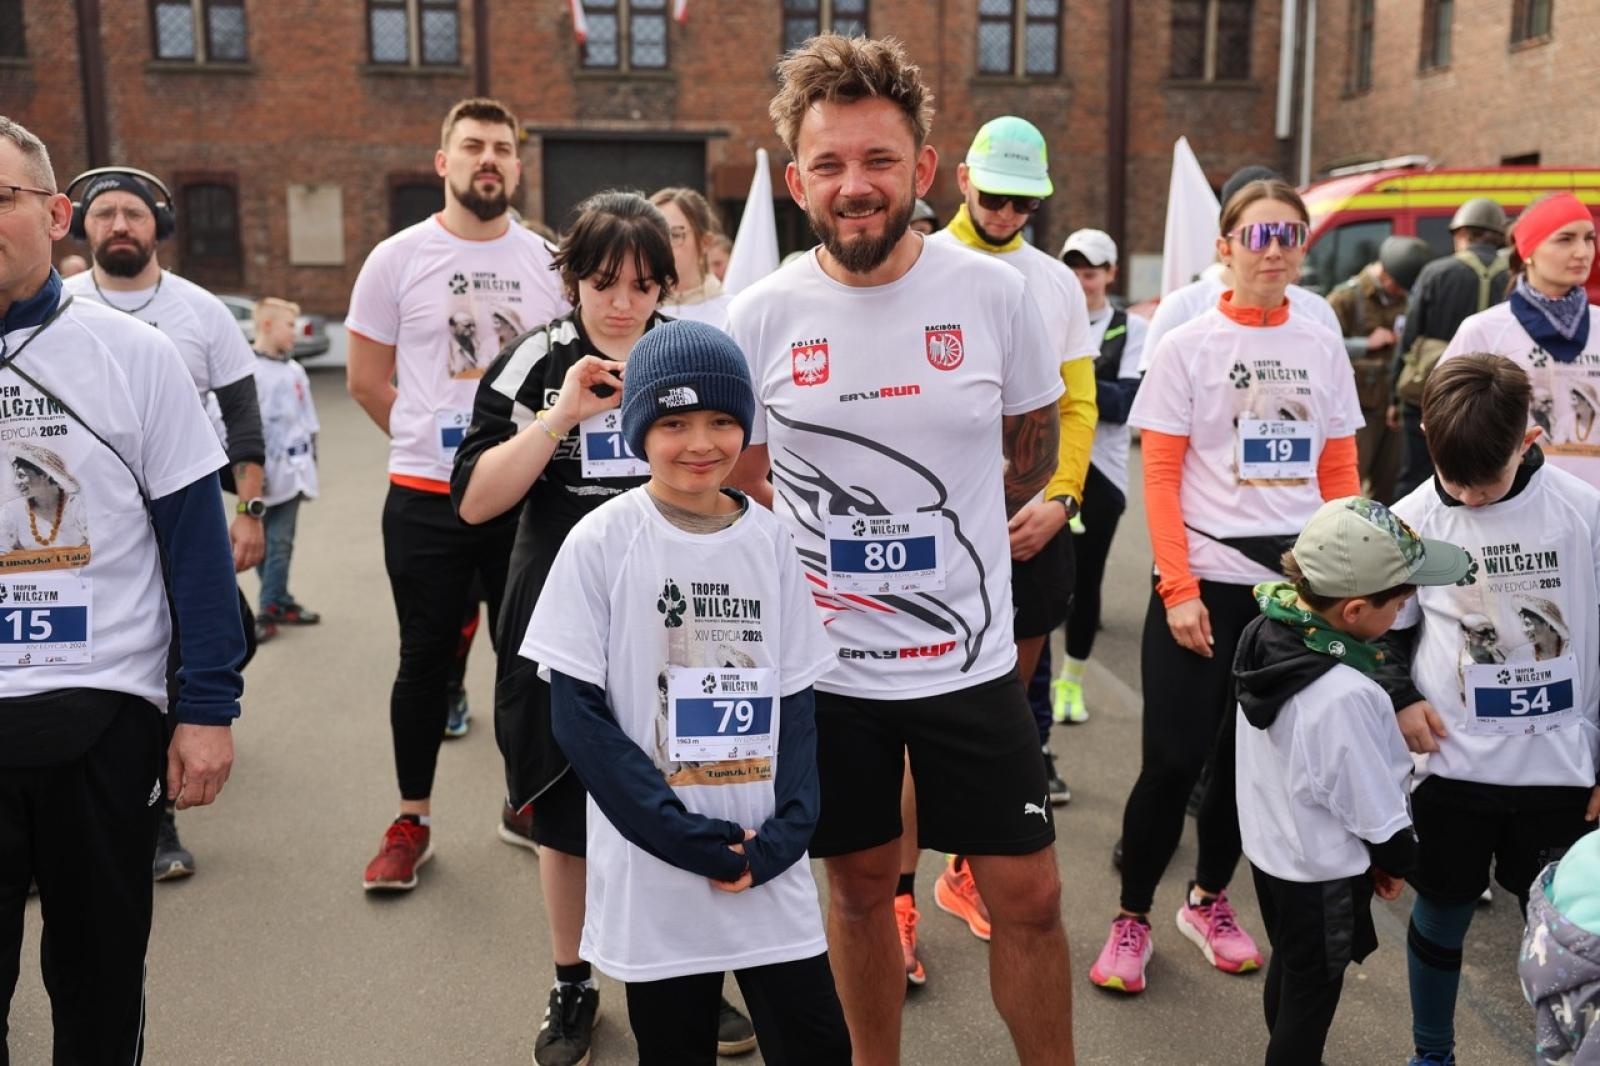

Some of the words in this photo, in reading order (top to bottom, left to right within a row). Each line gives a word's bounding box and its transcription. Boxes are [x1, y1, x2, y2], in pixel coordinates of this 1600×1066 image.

[791, 337, 828, 348] POLSKA
[1256, 368, 1309, 381] WILCZYM
[668, 387, 685, 396] THE
[1, 426, 38, 440] EDYCJA
[40, 425, 68, 437] 2026
[1266, 439, 1293, 462] 19
[870, 524, 910, 535] WILCZYM
[864, 541, 907, 571] 80
[1481, 543, 1521, 557] TROPEM
[1484, 551, 1558, 575] WILCZYM
[691, 582, 730, 596] TROPEM
[1505, 580, 1539, 593] EDYCJA
[1540, 577, 1562, 589] 2026
[13, 591, 59, 602] WILCZYM
[693, 596, 761, 620] WILCZYM
[4, 609, 53, 641] 15
[711, 629, 740, 641] EDYCJA
[742, 629, 764, 642] 2026
[1515, 670, 1552, 682] WILCZYM
[721, 681, 759, 692] WILCZYM
[1510, 686, 1551, 716] 54
[713, 700, 754, 733] 79
